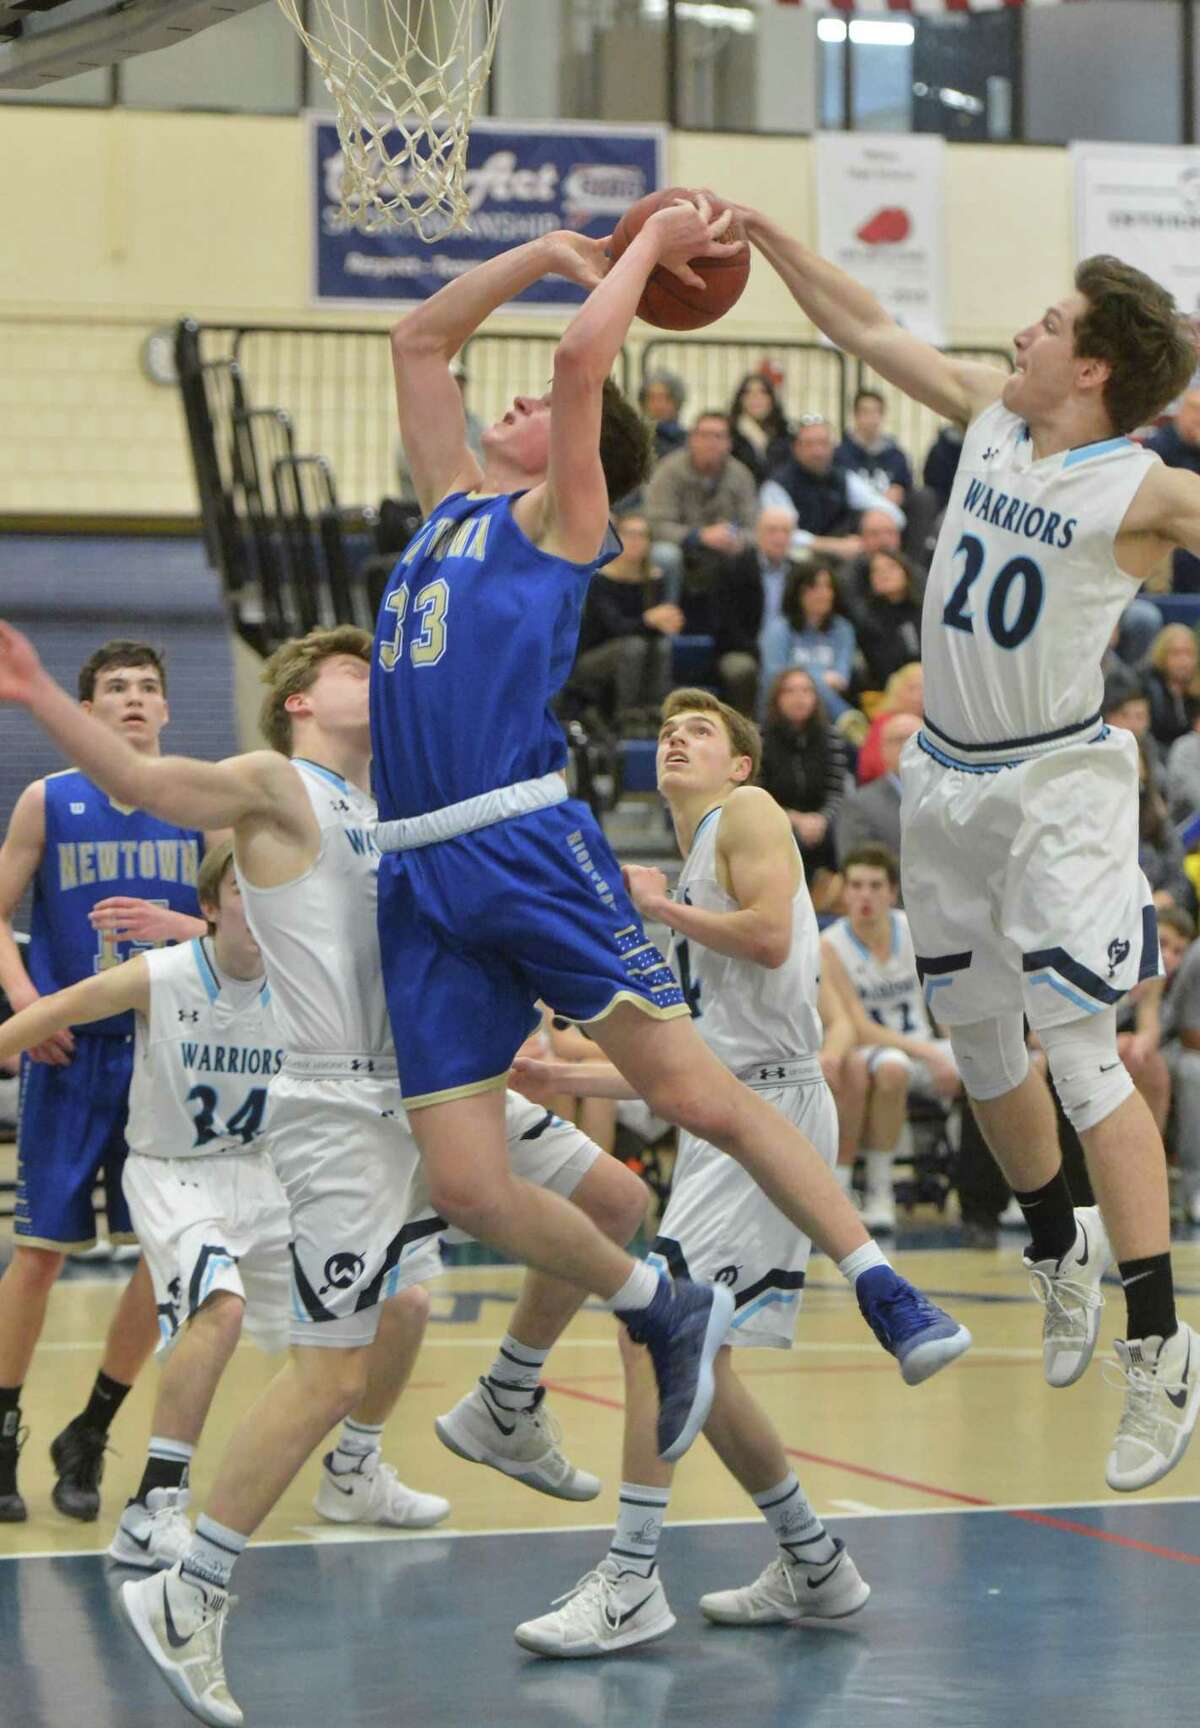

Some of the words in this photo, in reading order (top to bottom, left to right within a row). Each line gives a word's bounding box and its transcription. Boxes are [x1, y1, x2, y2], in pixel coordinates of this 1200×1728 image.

[963, 478, 1078, 549] WARRIORS
[379, 578, 449, 672] 33
[942, 531, 1045, 651] 20
[57, 839, 198, 891] NEWTOWN
[181, 1042, 284, 1075] WARRIORS
